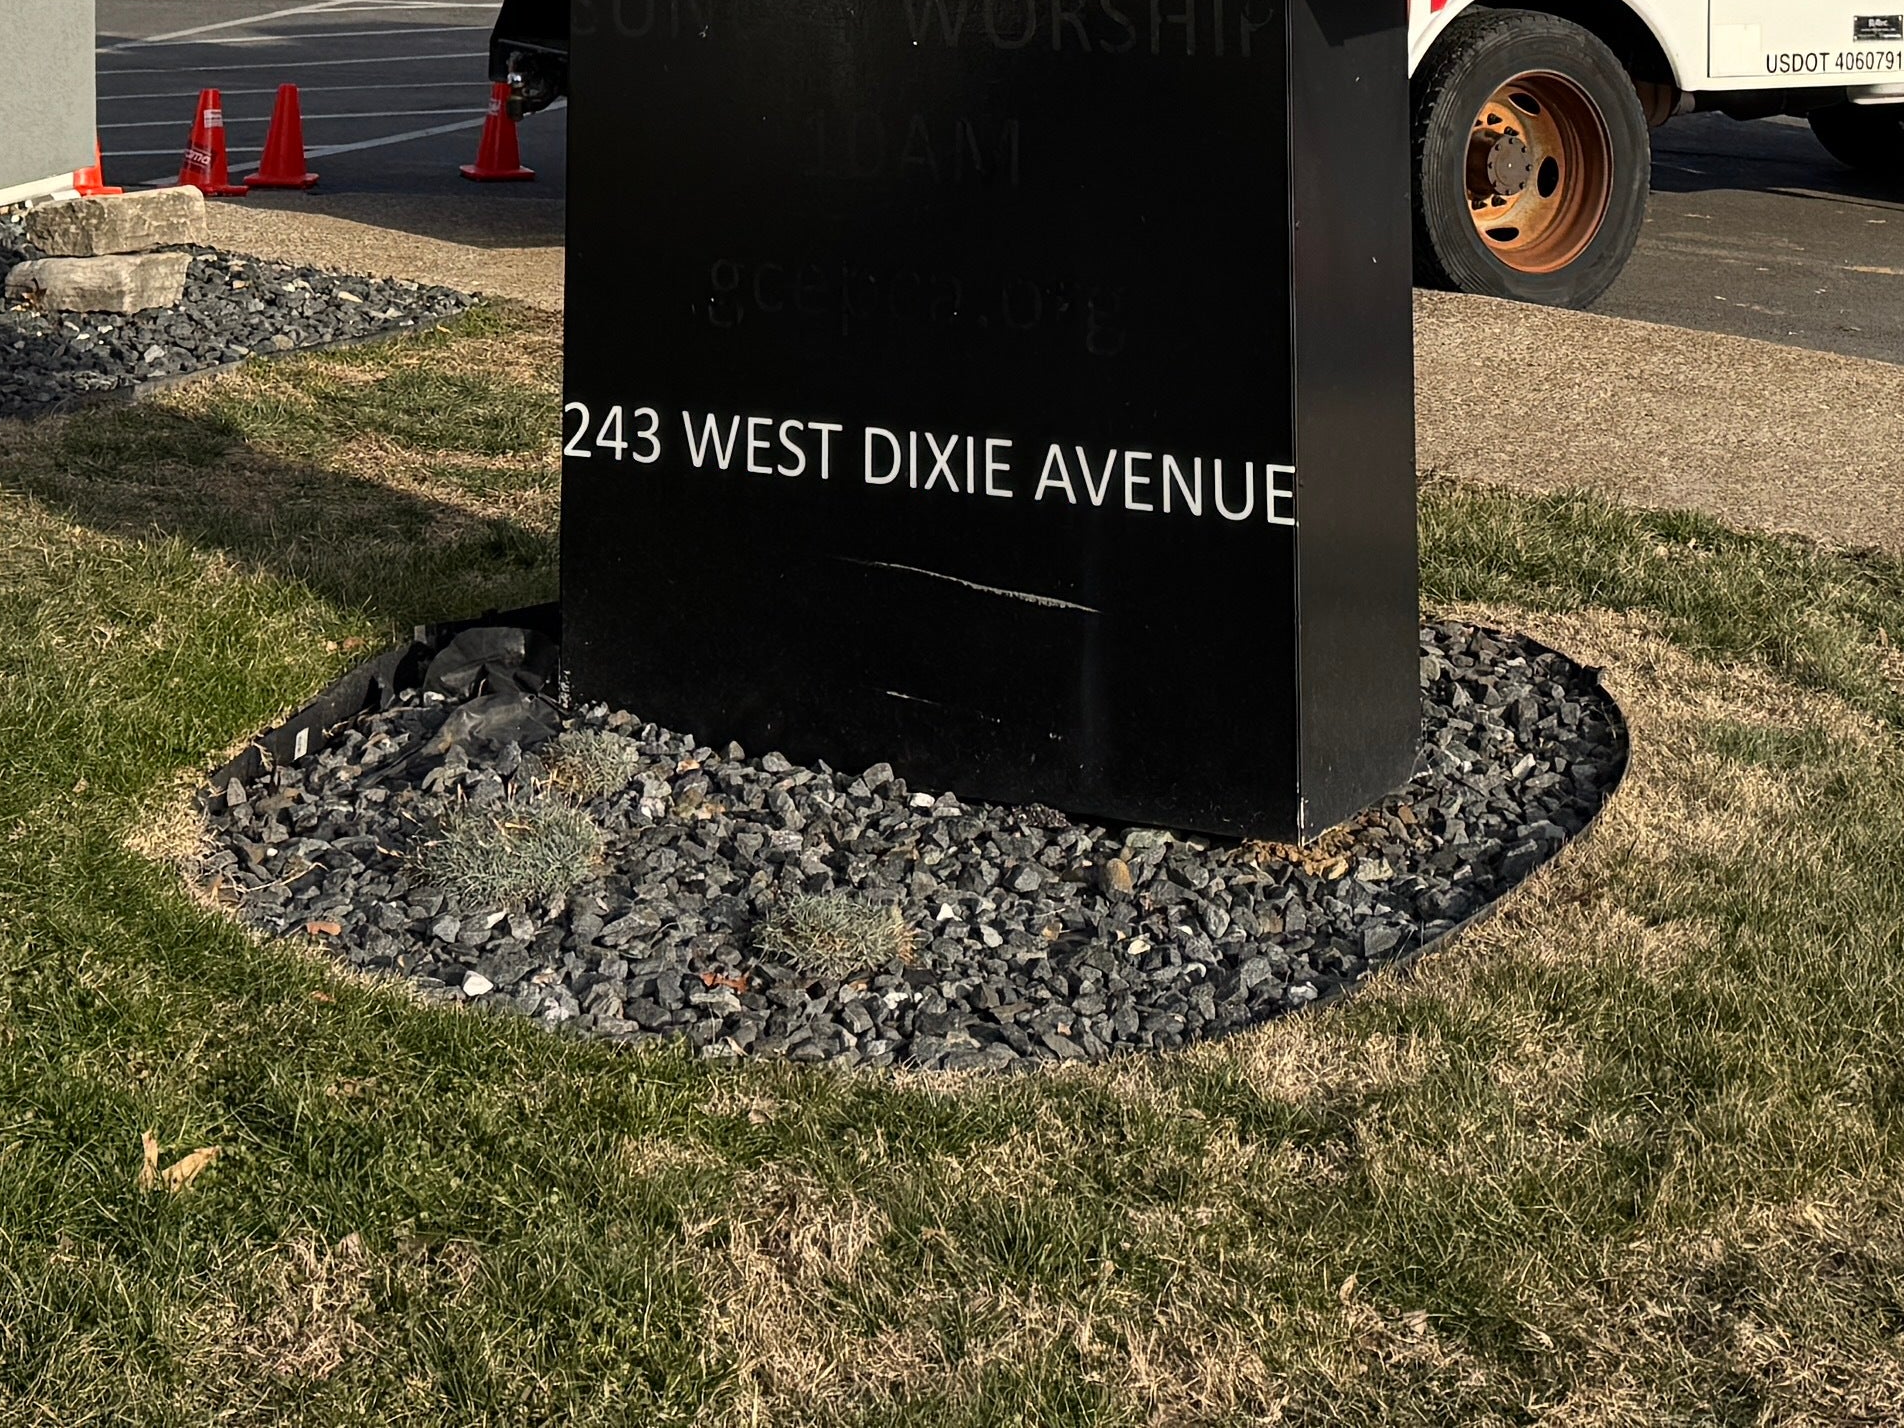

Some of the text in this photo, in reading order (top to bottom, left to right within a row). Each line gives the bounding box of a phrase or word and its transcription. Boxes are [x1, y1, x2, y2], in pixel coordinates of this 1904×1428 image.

[1765, 51, 1903, 74] USDOT 4060791
[564, 402, 1298, 526] 243 WEST DIXIE AVENUE
